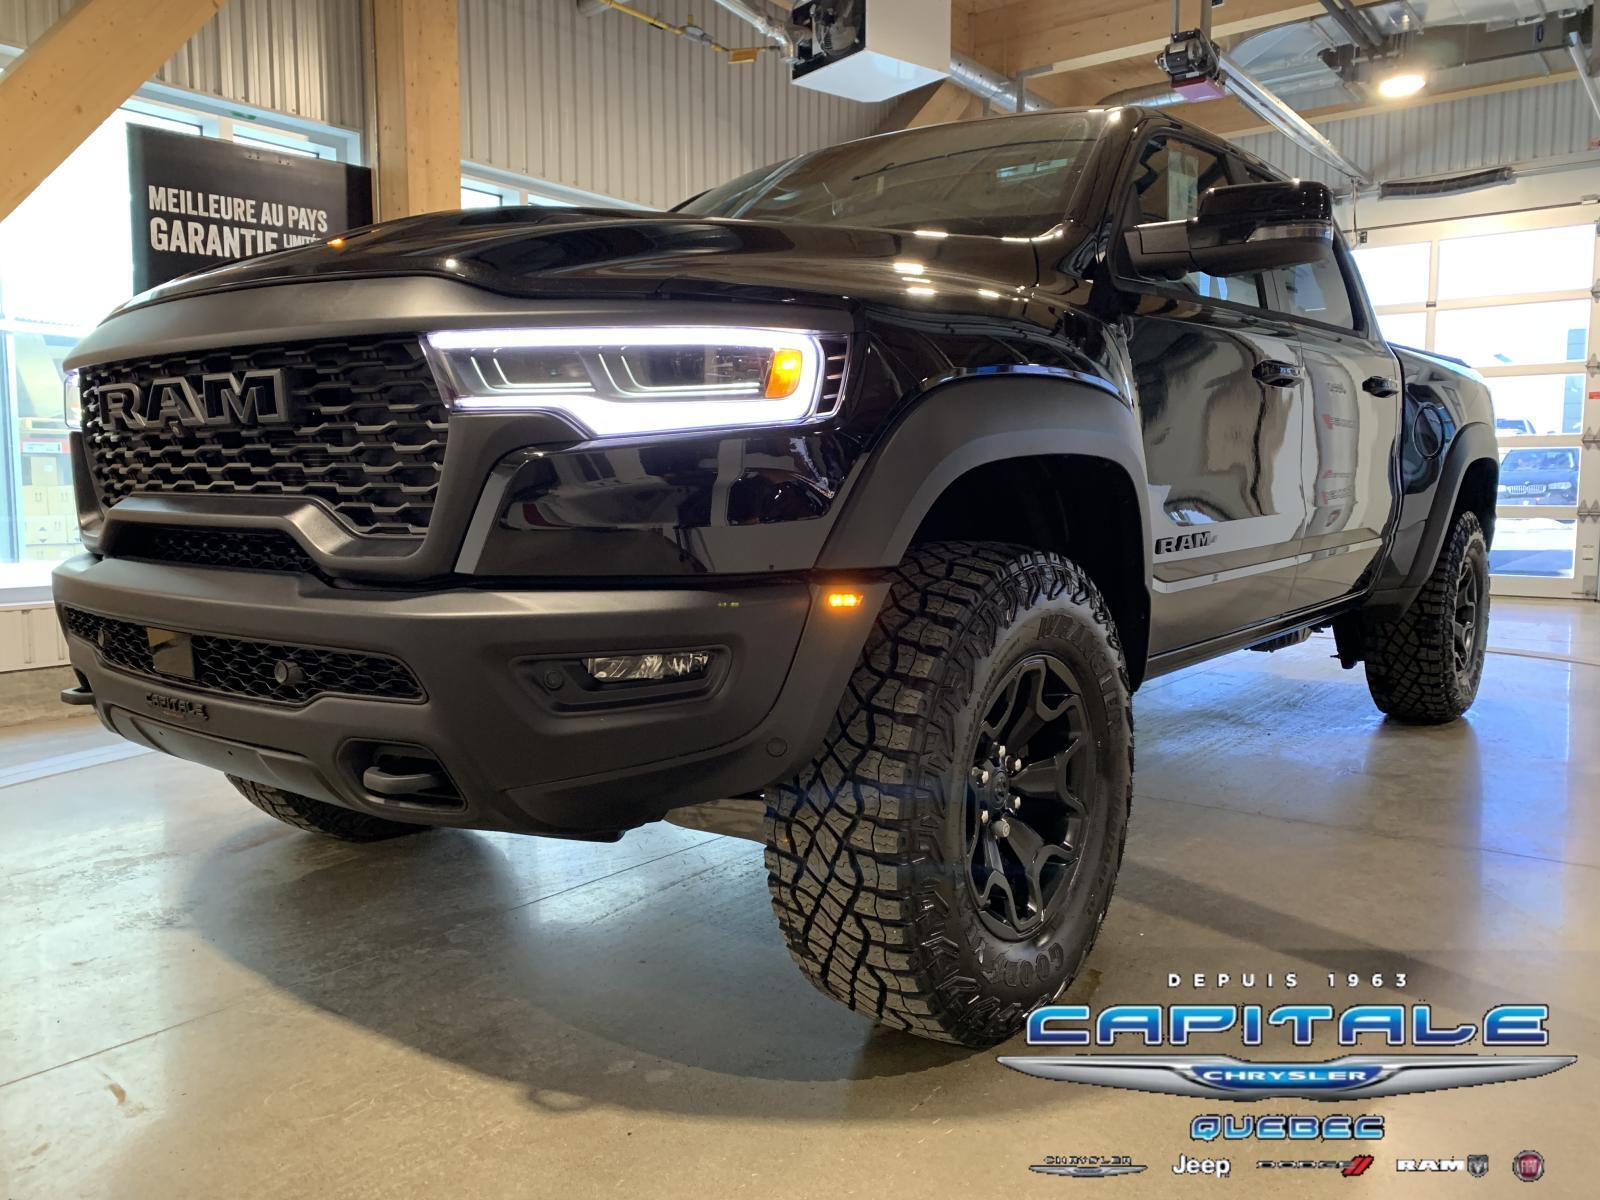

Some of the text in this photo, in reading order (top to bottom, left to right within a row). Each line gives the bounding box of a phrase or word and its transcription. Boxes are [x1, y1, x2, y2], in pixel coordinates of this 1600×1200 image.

[148, 185, 328, 233] MEILLEURE AU PAYS
[98, 368, 288, 431] RAM
[1154, 531, 1217, 555] RAM
